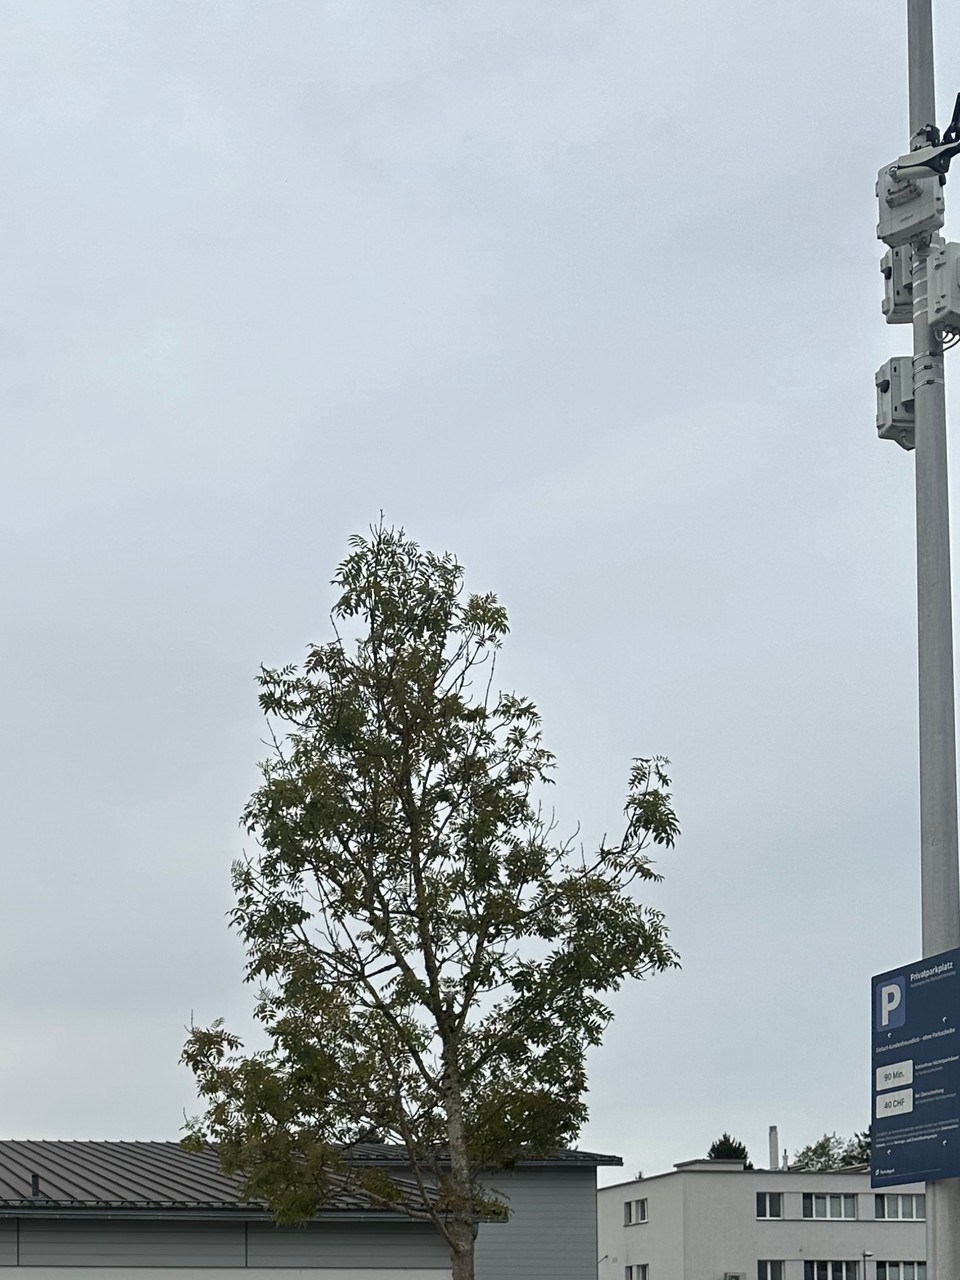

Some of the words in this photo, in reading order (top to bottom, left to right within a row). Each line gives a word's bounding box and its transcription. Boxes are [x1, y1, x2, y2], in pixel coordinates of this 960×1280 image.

[910, 962, 953, 982] Privatparkplatz
[881, 984, 901, 1026] P
[884, 1073, 892, 1082] 90
[893, 1070, 905, 1080] Min.
[884, 1101, 892, 1109] 40
[893, 1098, 905, 1108] CHF
